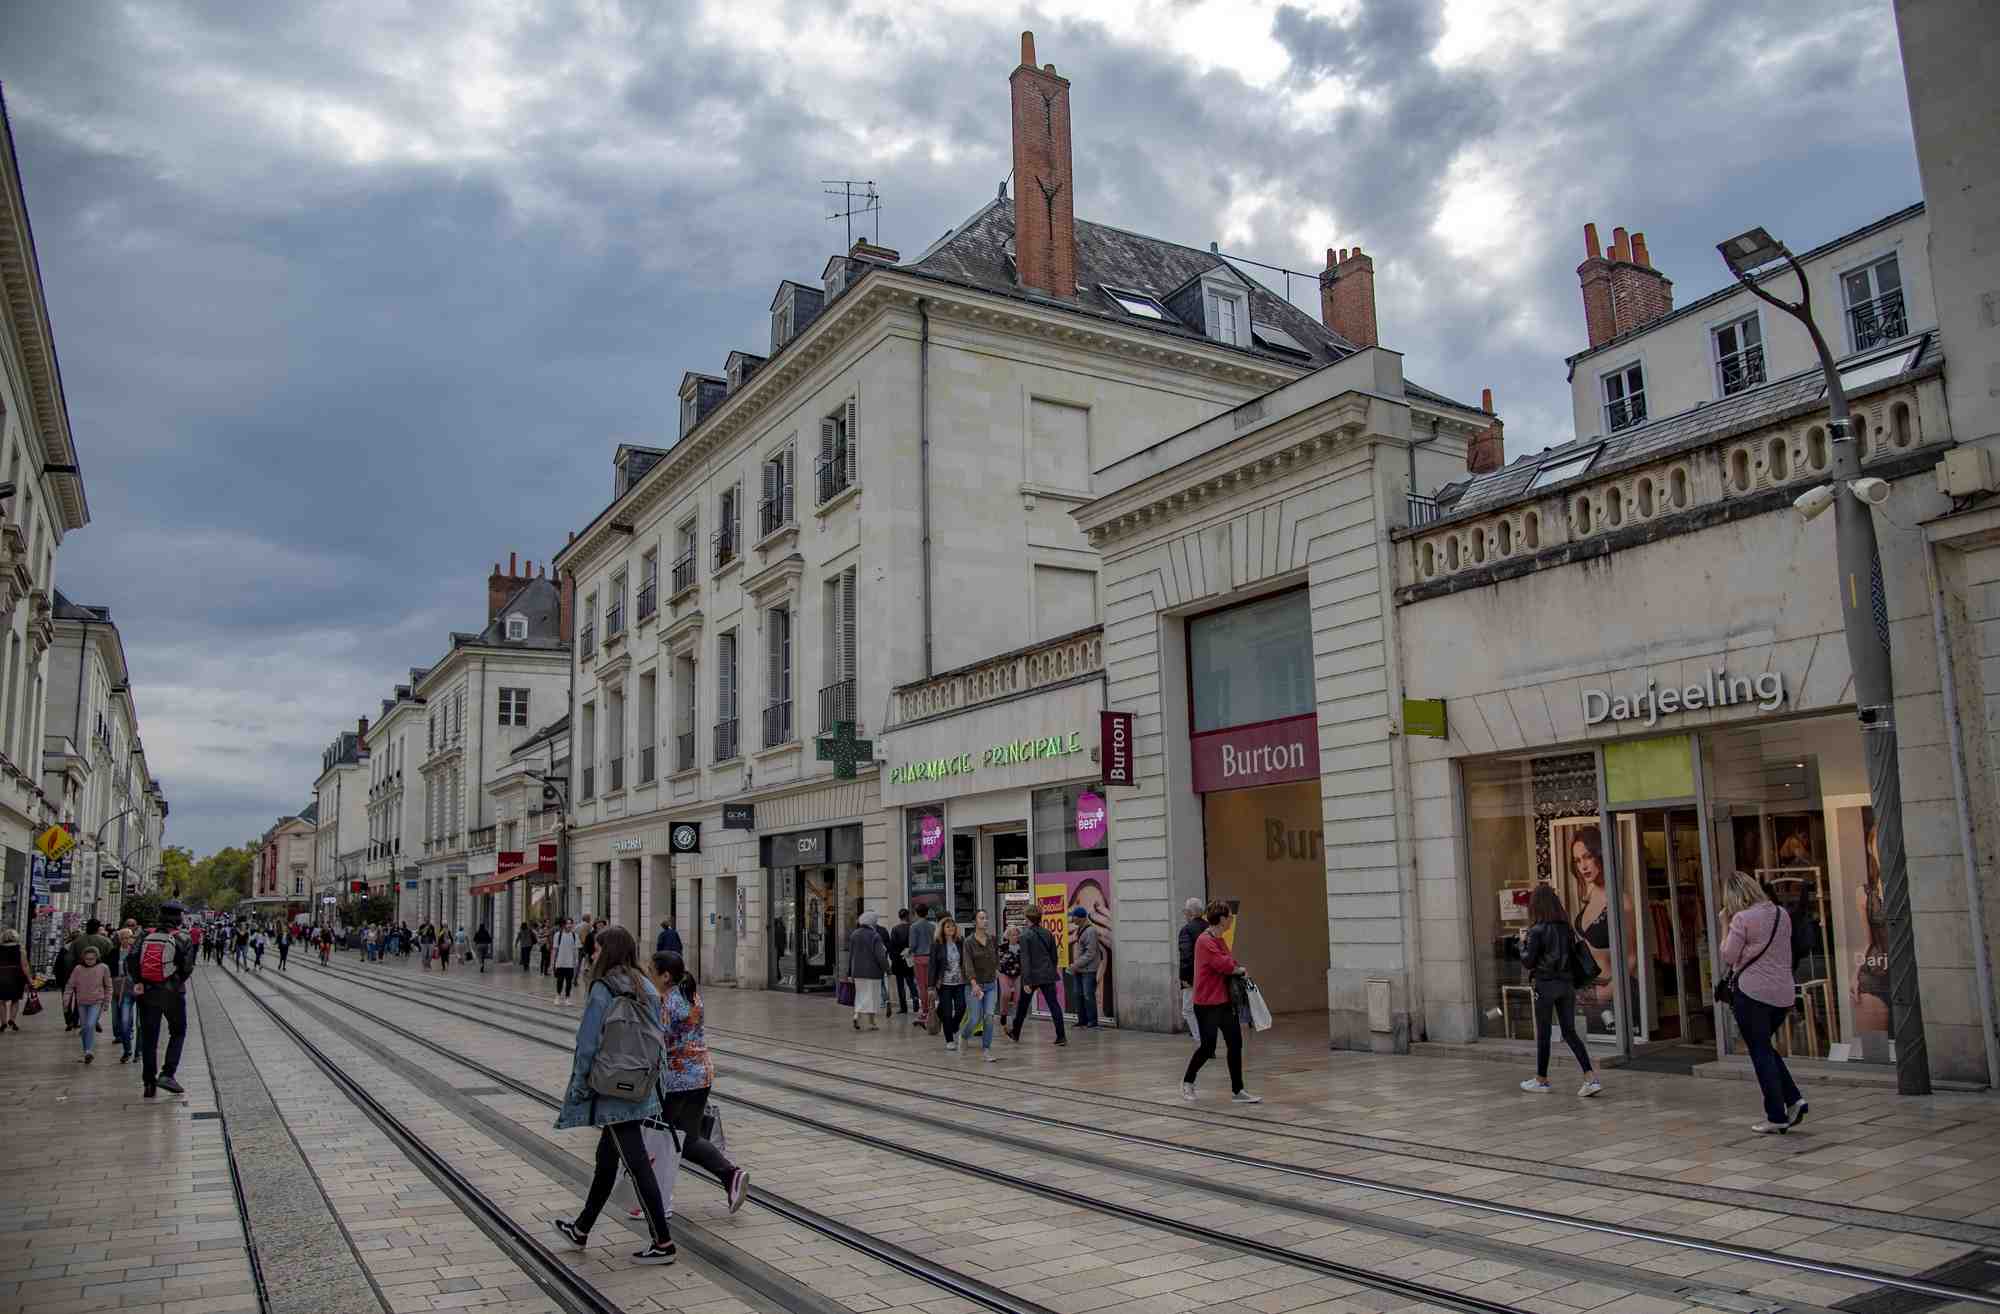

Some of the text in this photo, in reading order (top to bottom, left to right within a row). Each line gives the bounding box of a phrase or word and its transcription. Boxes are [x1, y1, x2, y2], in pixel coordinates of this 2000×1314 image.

[1583, 665, 1785, 727] Darjeeling
[889, 732, 1083, 784] PHARMACIE PRINCIPALE
[1110, 718, 1126, 780] Burton
[1222, 742, 1304, 777] Burton
[1041, 918, 1063, 933] 000
